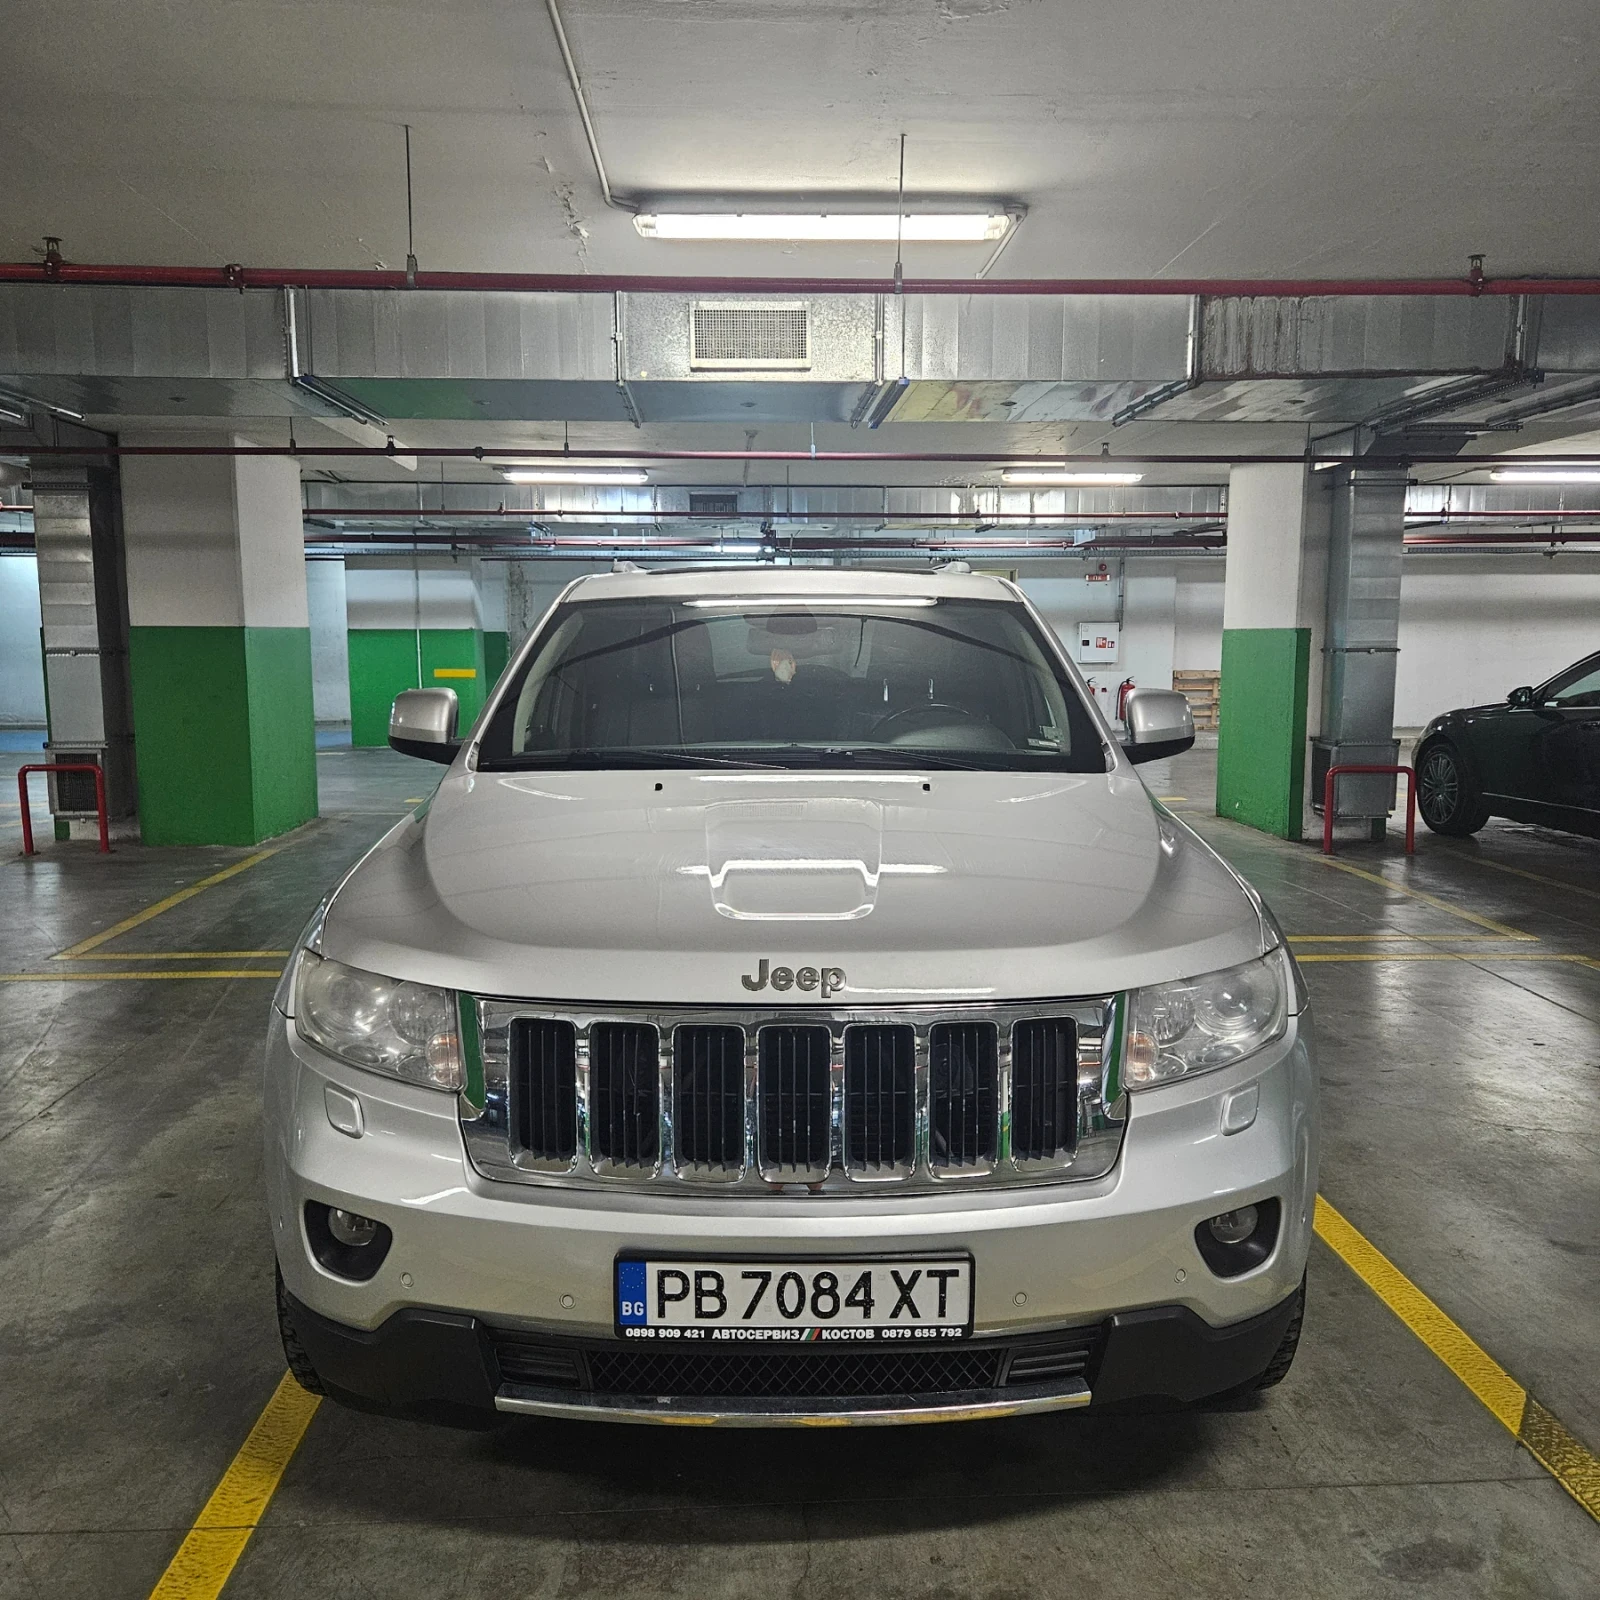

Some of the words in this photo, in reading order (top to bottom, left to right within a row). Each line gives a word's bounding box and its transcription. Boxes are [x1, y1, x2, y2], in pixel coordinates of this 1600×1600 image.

[741, 959, 846, 998] Jeep
[657, 1269, 728, 1319] PB
[741, 1270, 875, 1319] 7084
[889, 1269, 960, 1319] XT
[621, 1301, 645, 1316] BG
[625, 1327, 656, 1338] 0898
[658, 1328, 681, 1338] 909
[684, 1328, 705, 1339] 421
[712, 1329, 800, 1340] АВТОСЕРВИЗ
[821, 1328, 875, 1340] КОСТОВ
[881, 1328, 911, 1338] 0879
[914, 1328, 937, 1338] 655
[940, 1327, 963, 1337] 792
